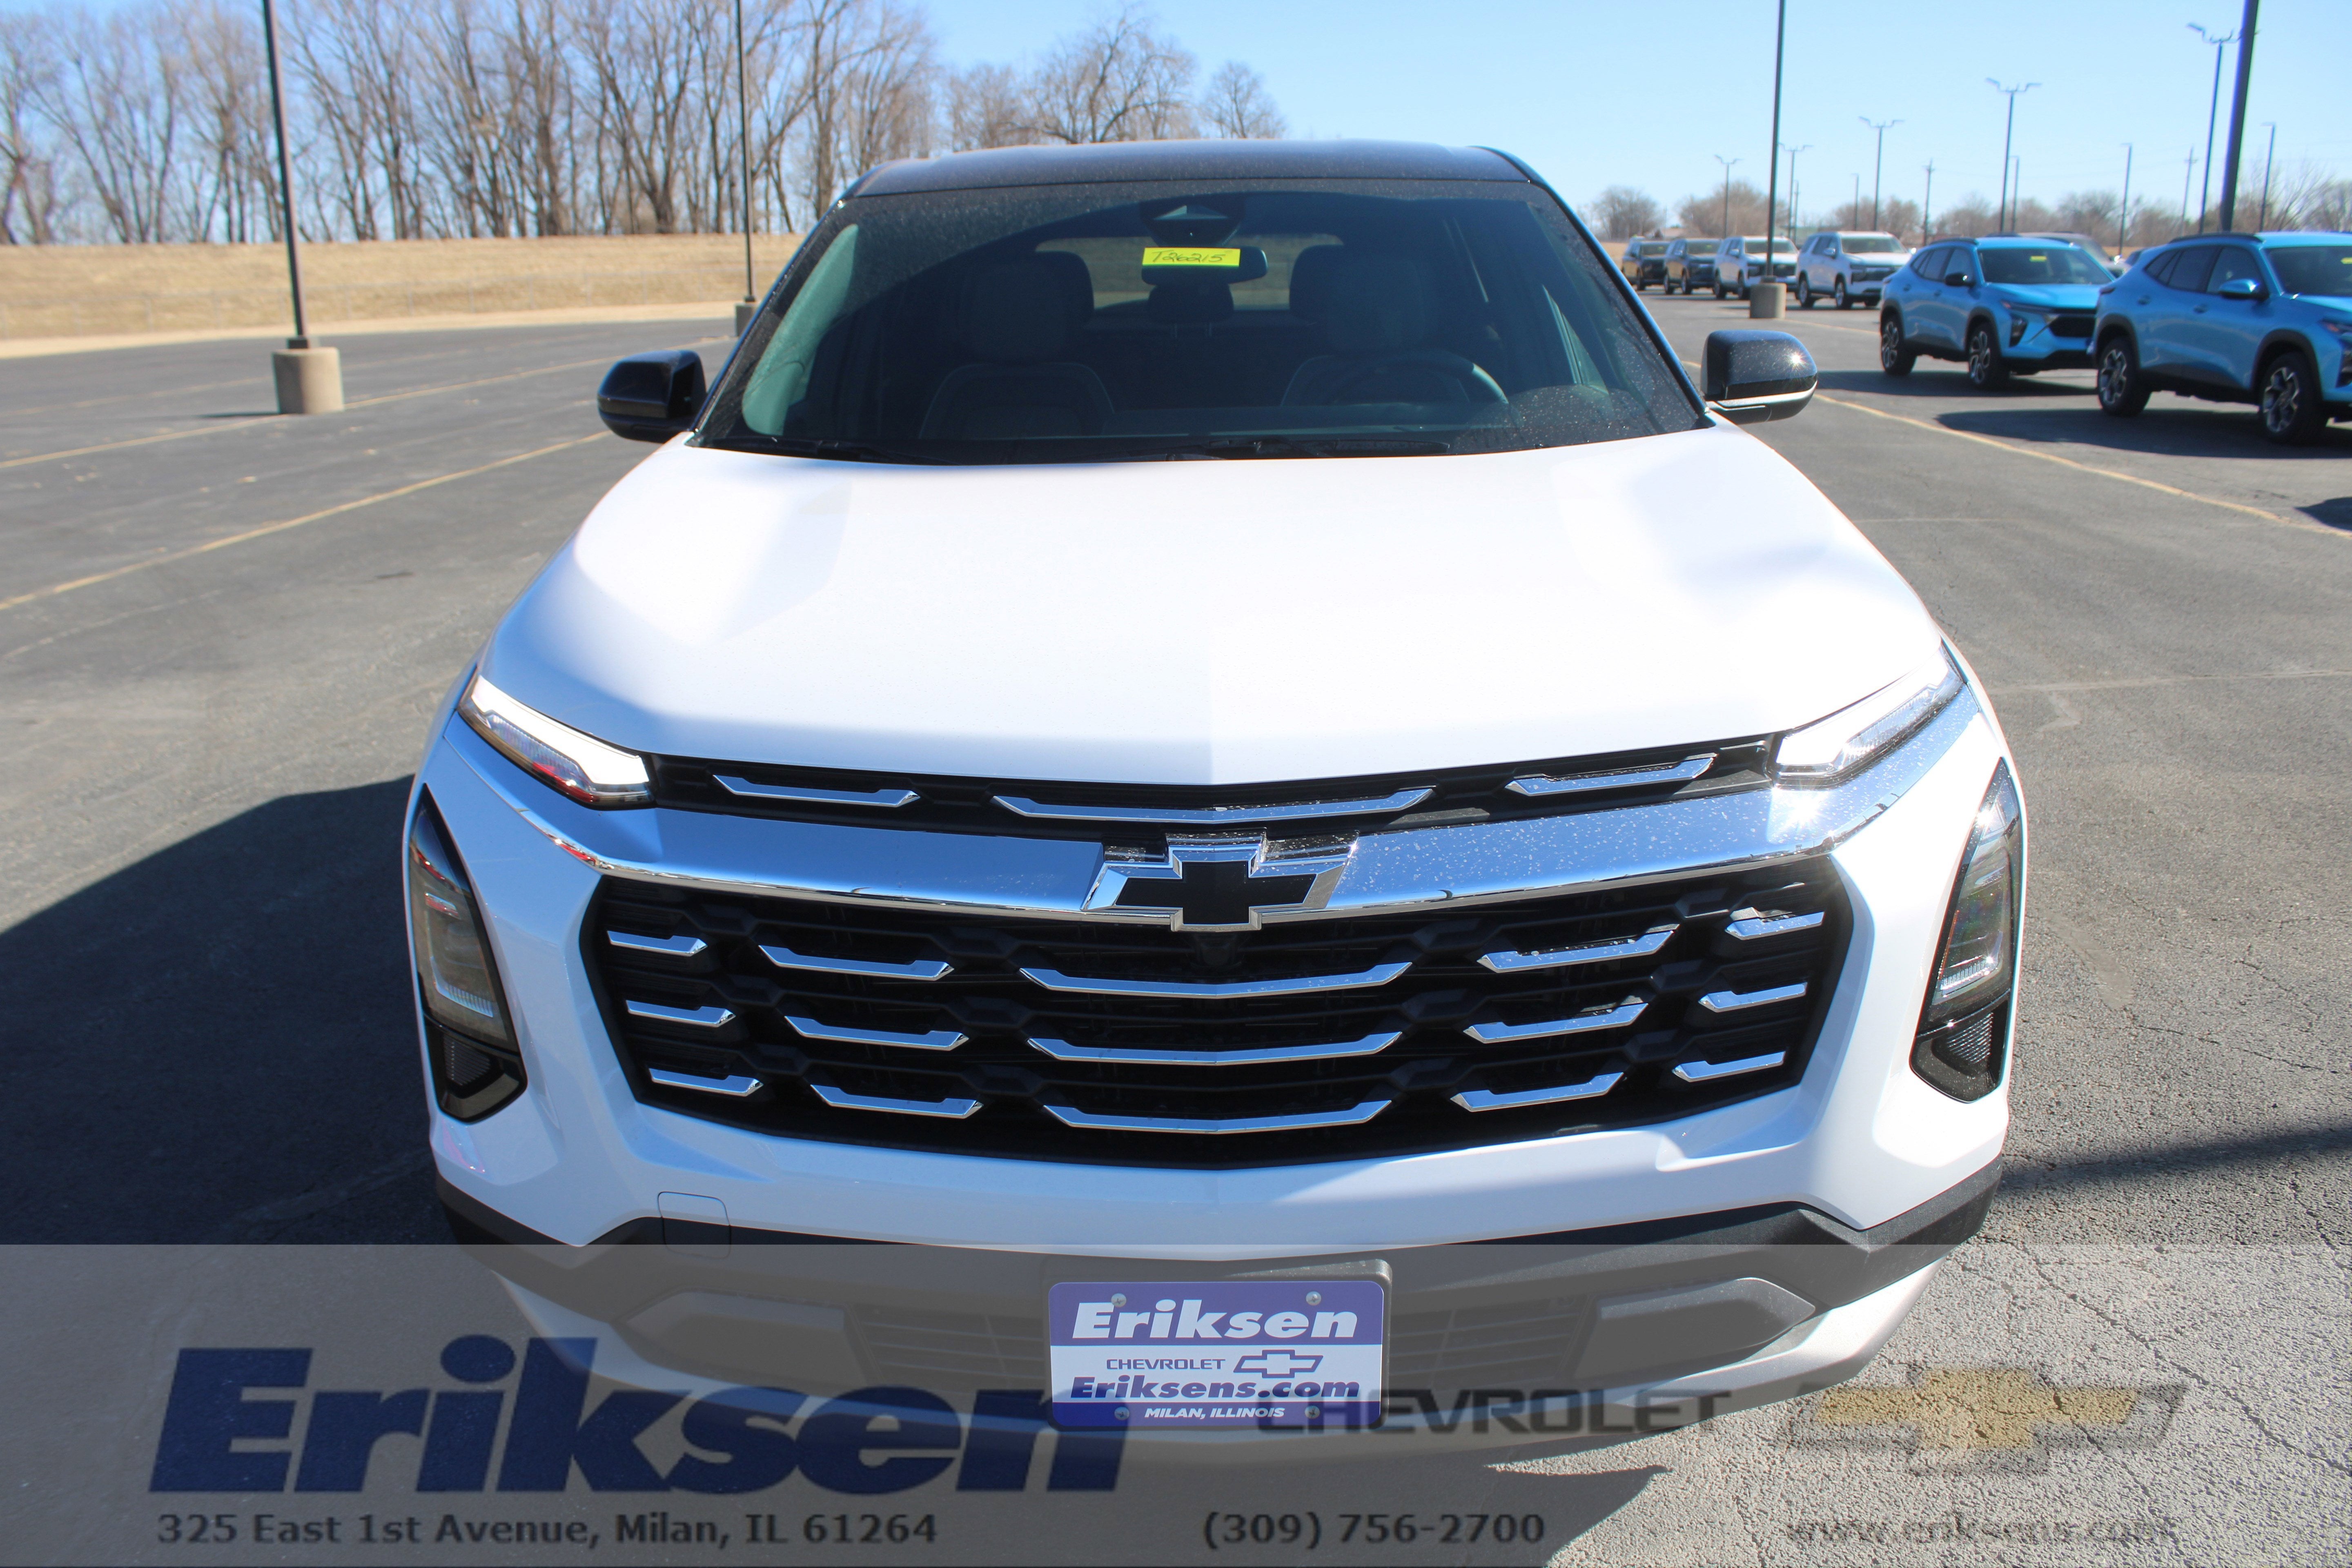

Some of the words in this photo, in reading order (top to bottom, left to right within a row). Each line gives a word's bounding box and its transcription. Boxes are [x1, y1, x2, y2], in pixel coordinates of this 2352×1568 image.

[1152, 249, 1226, 263] T26215
[1072, 1299, 1358, 1339] Eriksen
[1106, 1359, 1225, 1370] CHEVROLET
[1070, 1375, 1360, 1398] Eriksens.com
[1145, 1408, 1206, 1419] MILAN,
[1209, 1408, 1285, 1418] ILLINOIS
